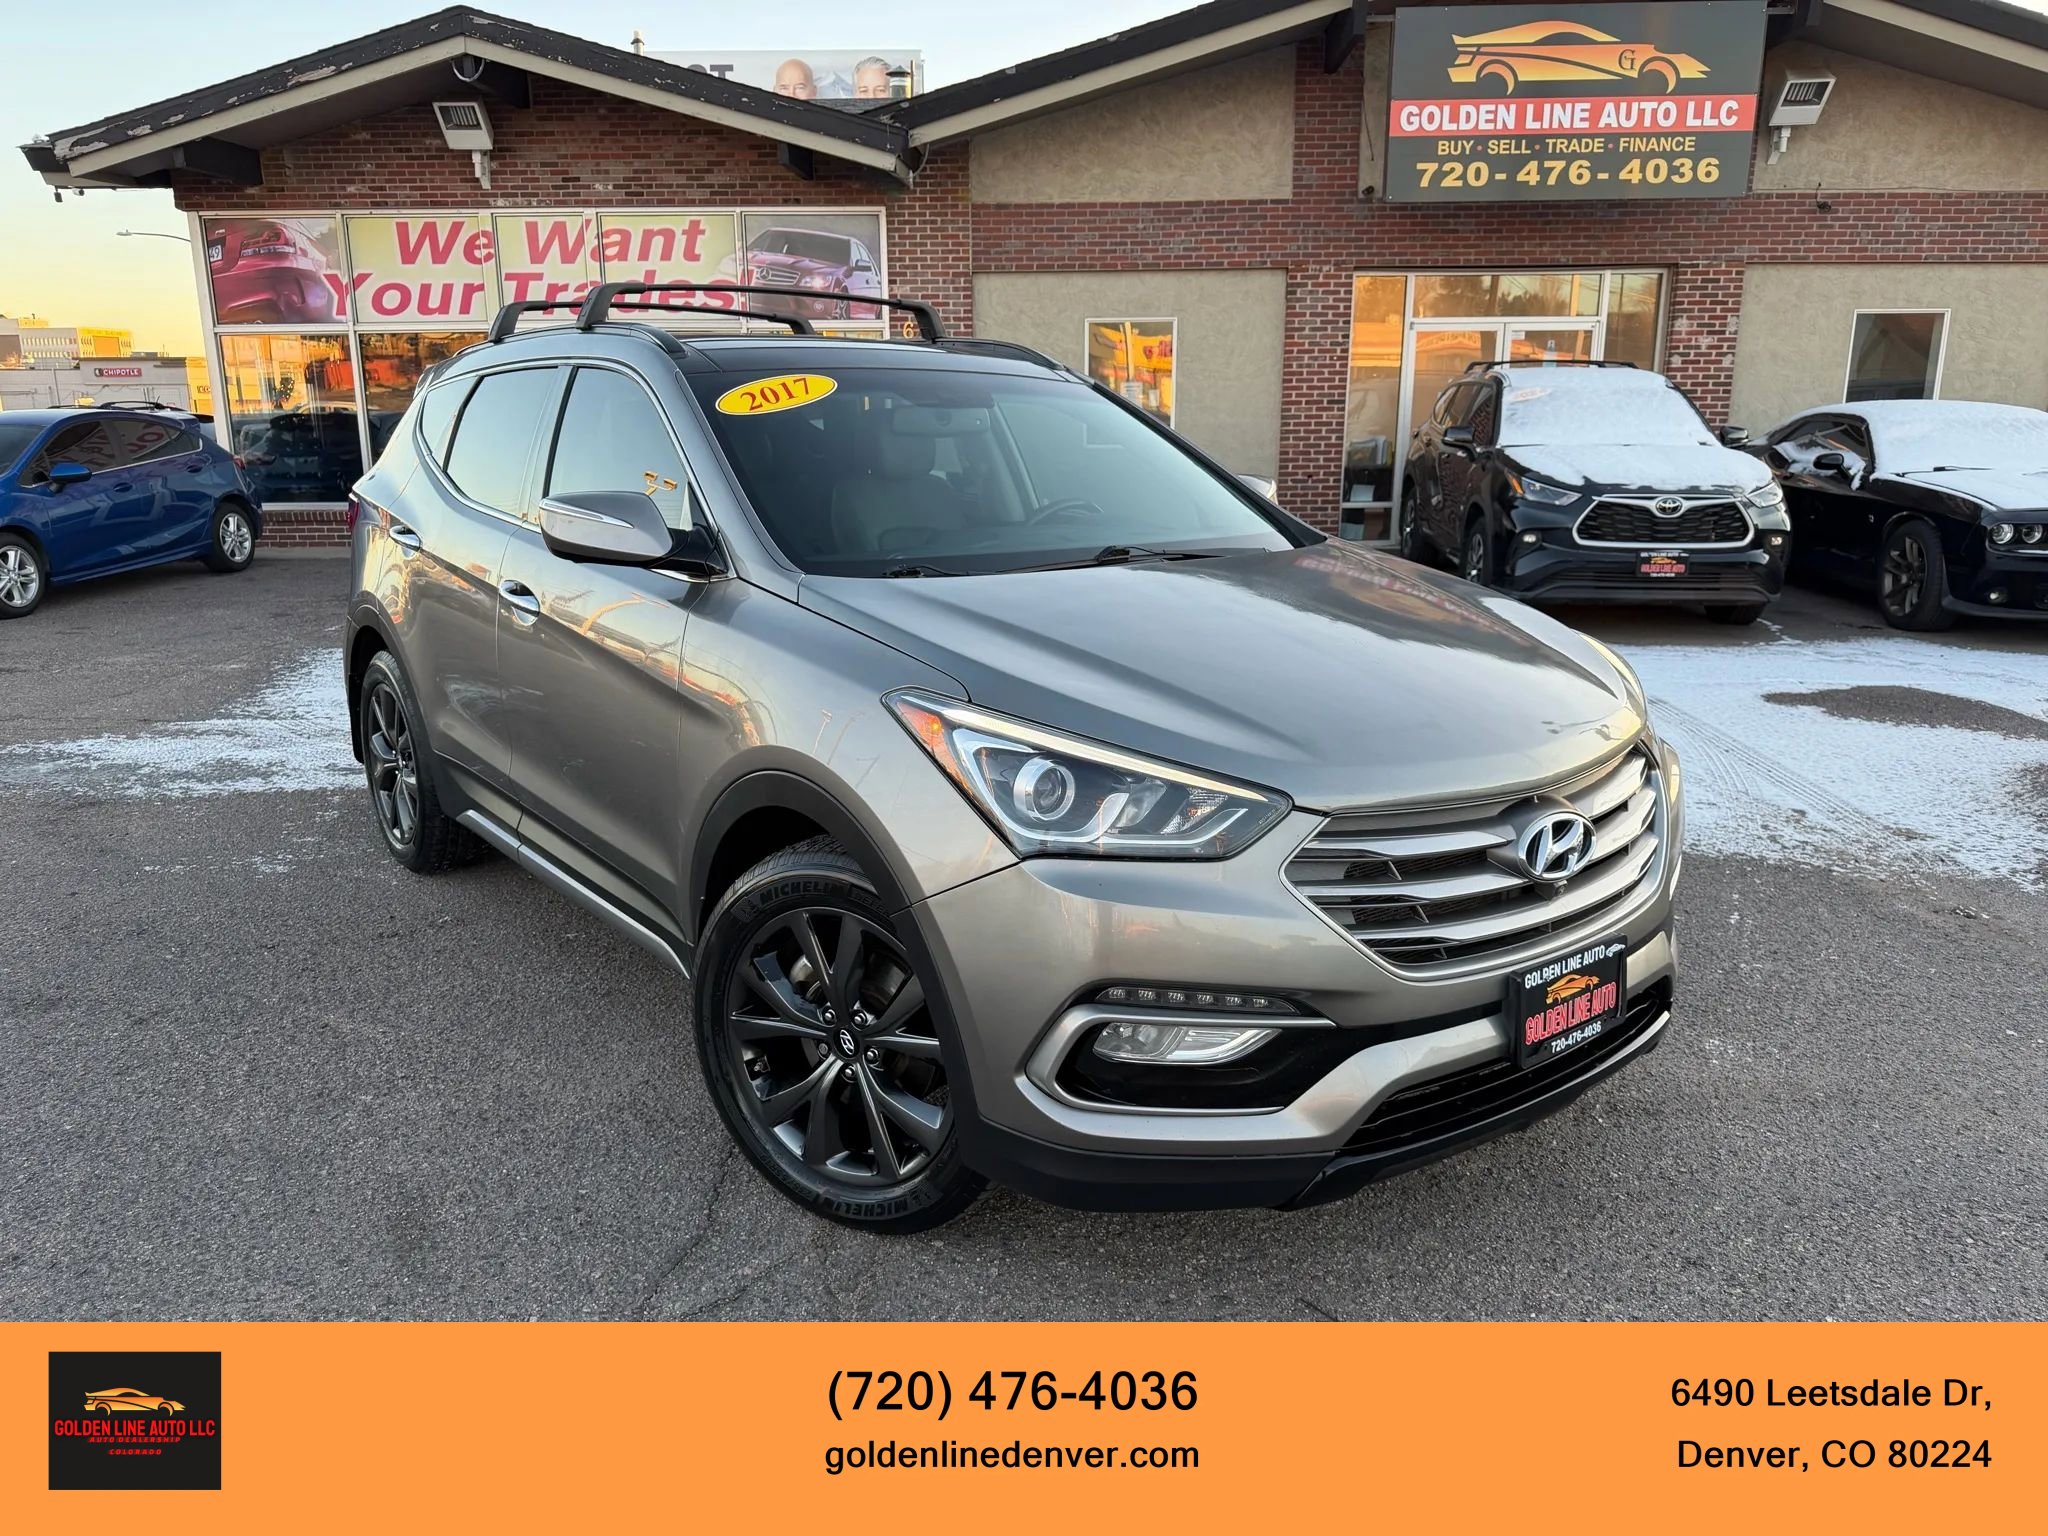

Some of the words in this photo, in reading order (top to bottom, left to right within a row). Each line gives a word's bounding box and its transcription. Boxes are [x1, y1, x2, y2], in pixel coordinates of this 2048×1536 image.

[1618, 48, 1636, 71] G
[1400, 104, 1515, 131] GOLDEN
[1525, 102, 1590, 129] LINE
[1598, 100, 1677, 128] AUTO
[1685, 100, 1739, 127] LLC
[1437, 140, 1474, 156] BUY
[1487, 139, 1531, 155] SELL
[1546, 138, 1604, 154] TRADE
[1619, 136, 1695, 153] FINANCE
[395, 221, 495, 265] We
[524, 219, 706, 264] Want
[323, 273, 485, 316] Your
[103, 369, 139, 377] CHIPOTLE
[740, 377, 809, 411] 2017
[1562, 954, 1581, 973] LINE
[1583, 945, 1605, 966] AUTO
[1525, 1002, 1567, 1045] GOLDEN
[1568, 992, 1591, 1028] LINE
[1591, 981, 1616, 1017] AUTO
[1551, 1021, 1601, 1053] 720-476-4036
